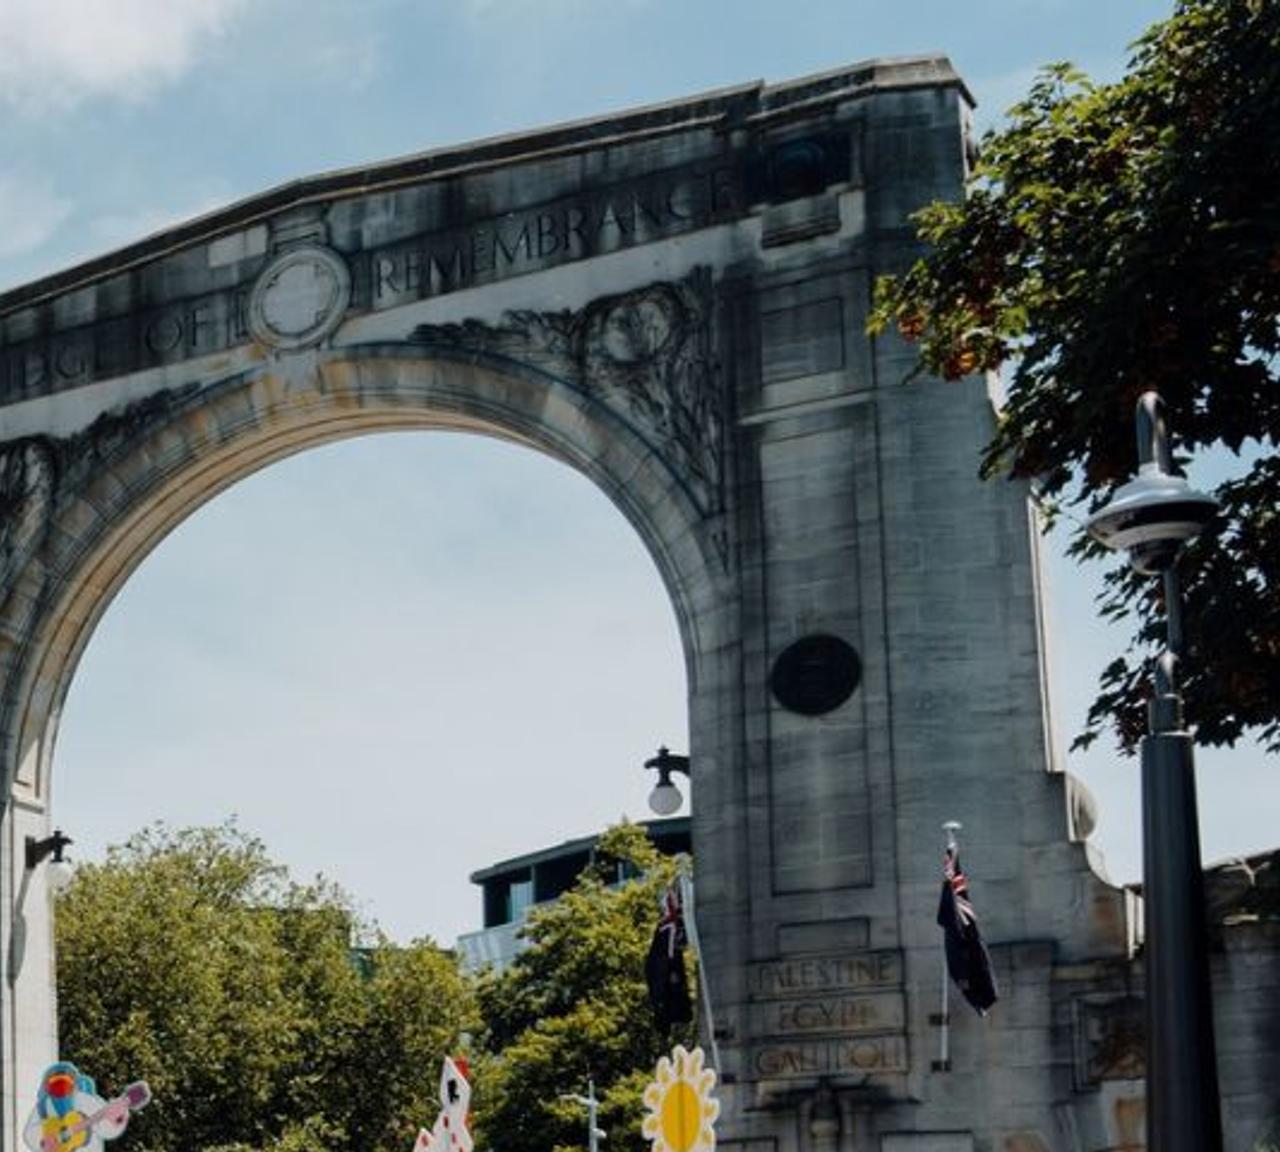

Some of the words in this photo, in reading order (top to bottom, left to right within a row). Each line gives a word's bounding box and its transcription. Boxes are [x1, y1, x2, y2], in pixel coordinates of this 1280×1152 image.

[144, 301, 208, 355] OF
[376, 169, 734, 298] REMEMBRANCE
[758, 953, 896, 990] PALESTINE
